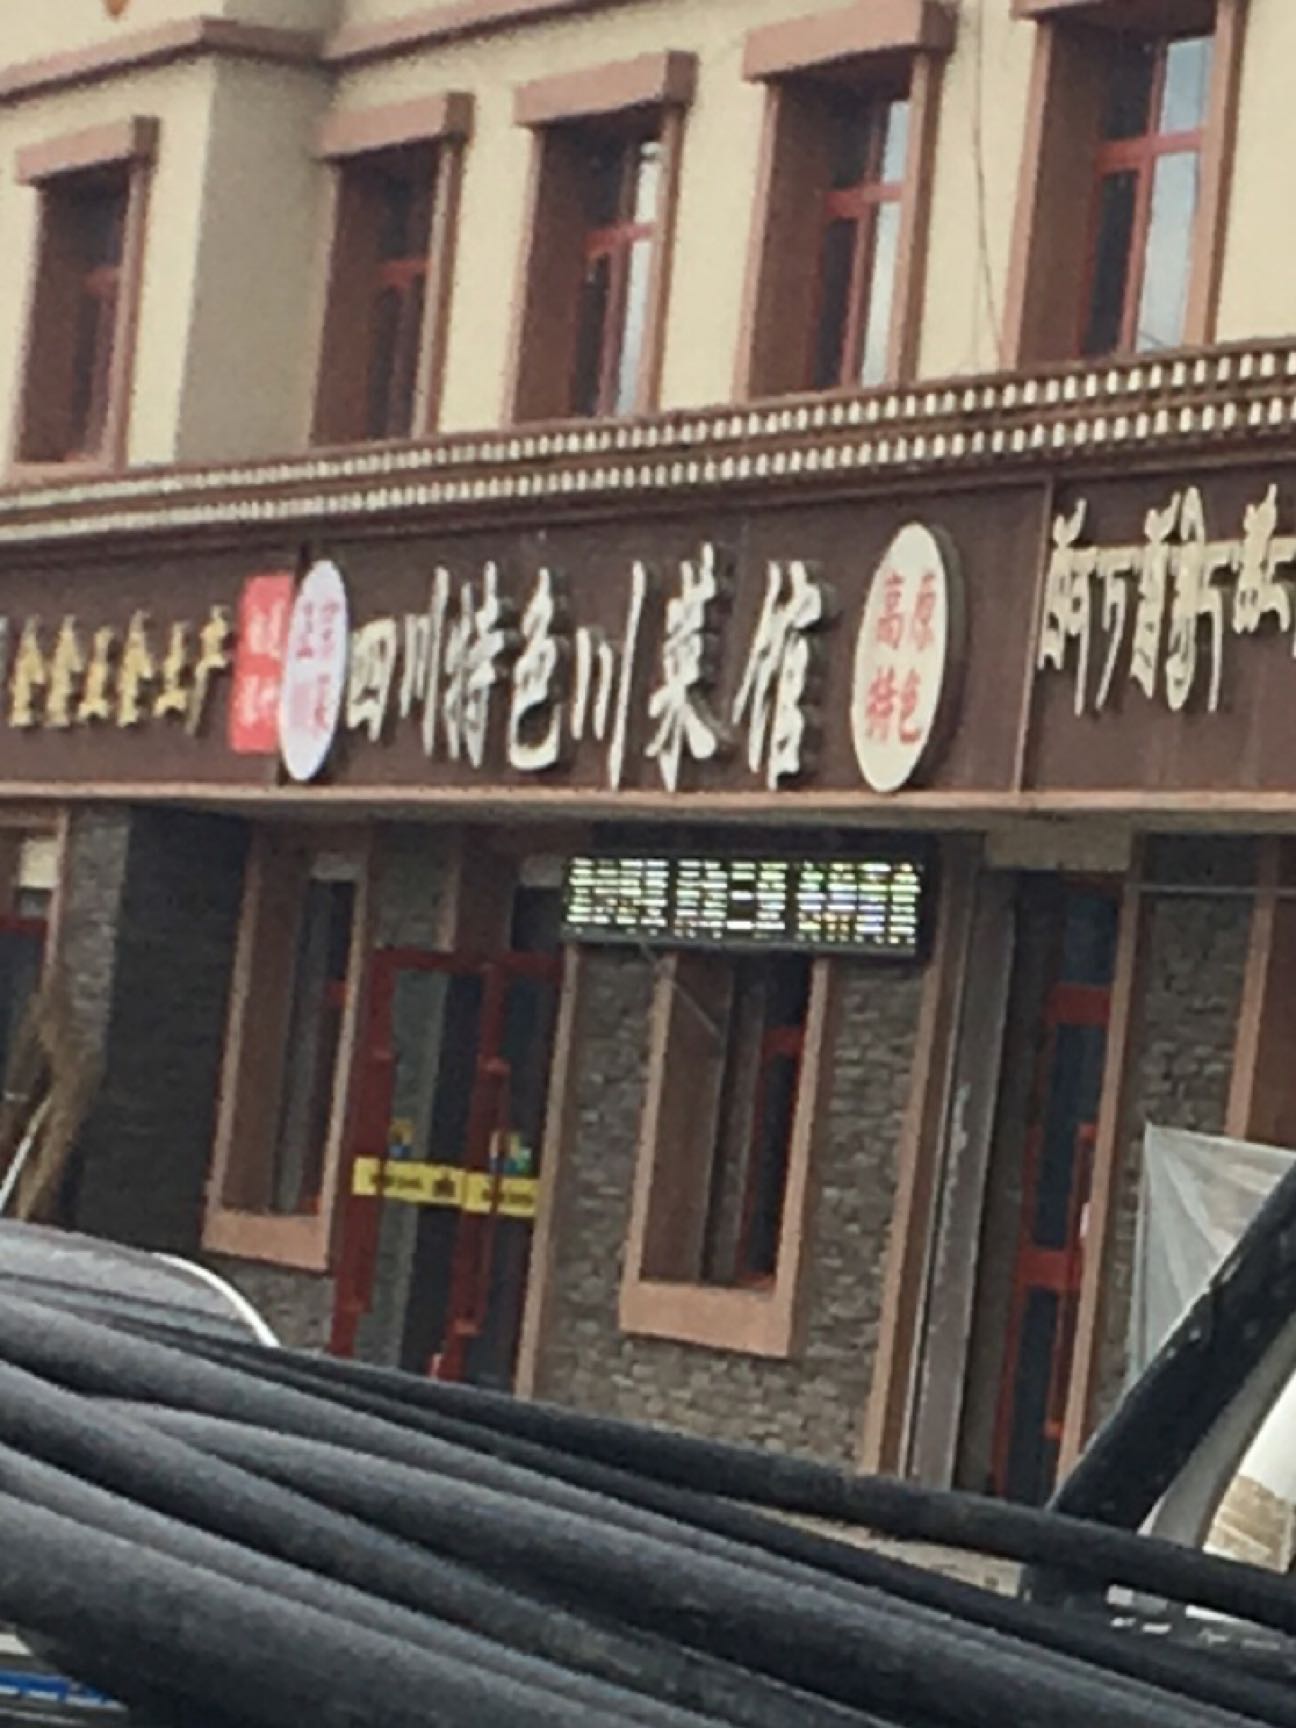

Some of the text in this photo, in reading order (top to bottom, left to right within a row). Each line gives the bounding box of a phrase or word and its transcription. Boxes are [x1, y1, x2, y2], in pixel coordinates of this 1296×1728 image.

[345, 540, 824, 792] 四川特色川菜馆
